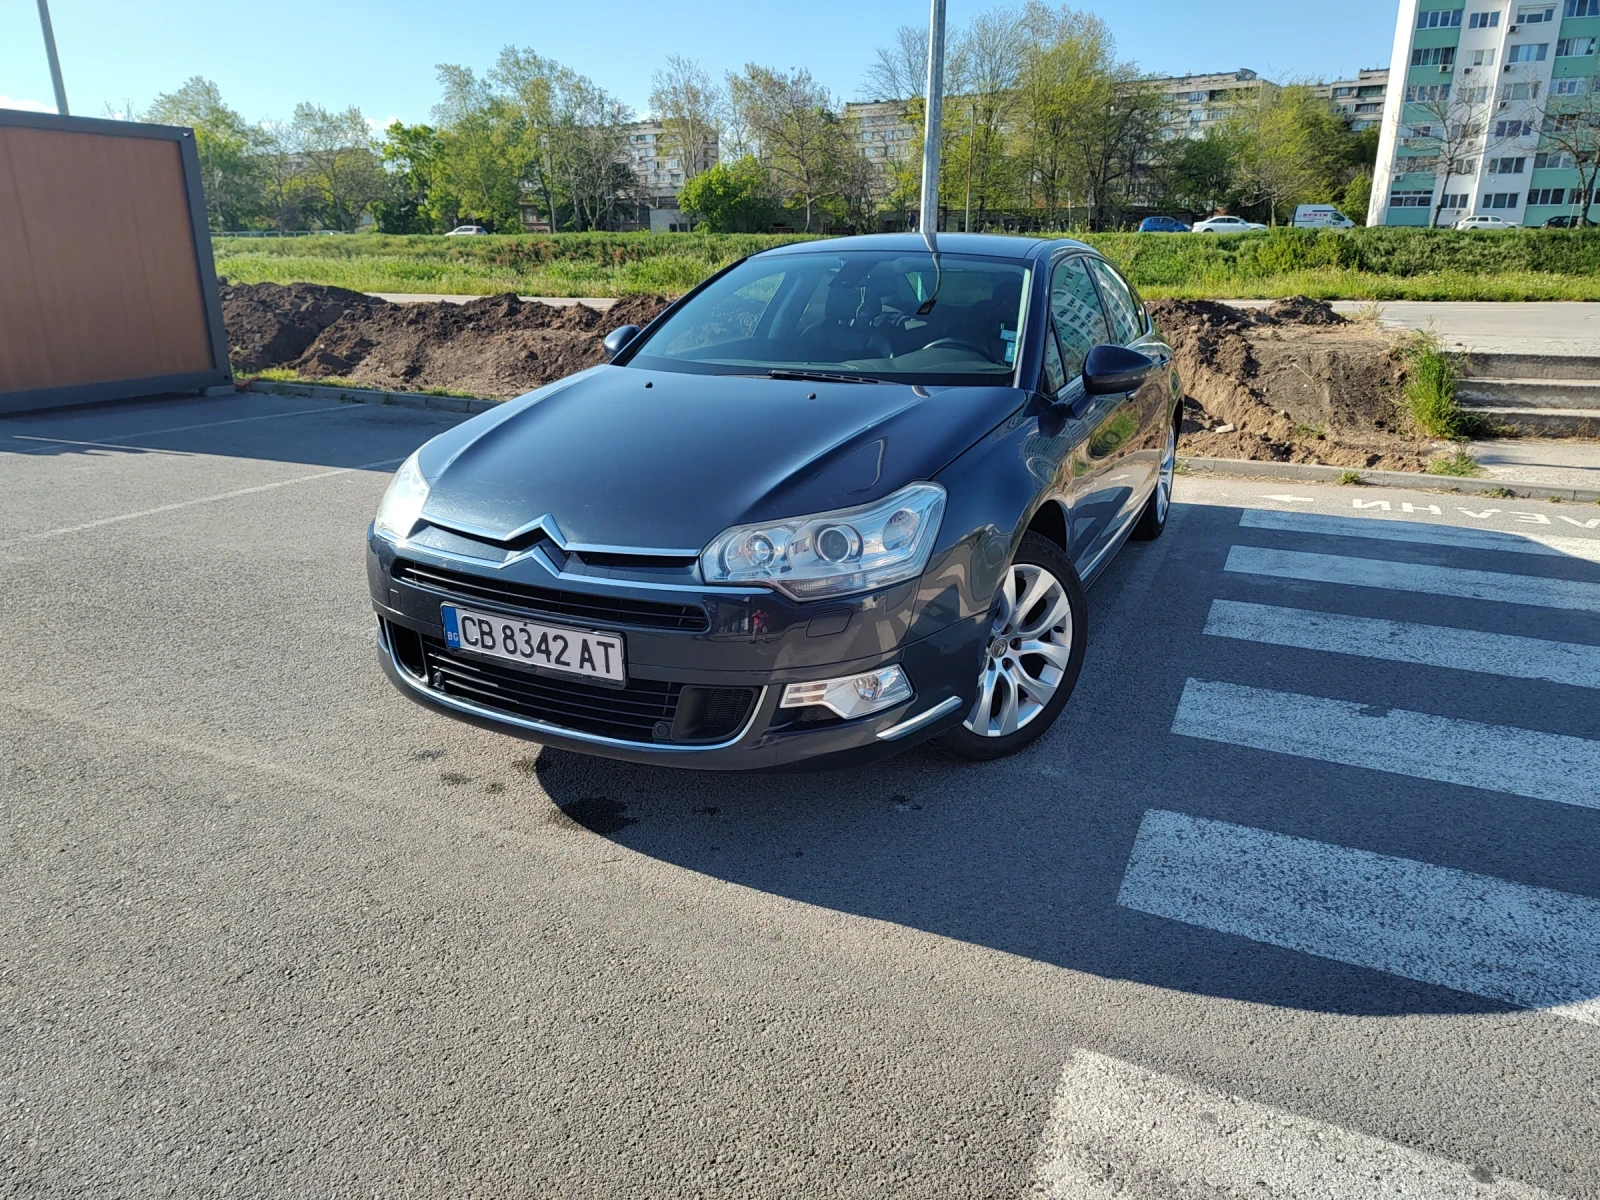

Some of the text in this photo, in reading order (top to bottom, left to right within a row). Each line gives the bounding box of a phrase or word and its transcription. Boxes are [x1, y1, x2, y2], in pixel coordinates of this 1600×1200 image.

[447, 631, 459, 642] BG
[461, 615, 616, 674] CB 8342 AT
